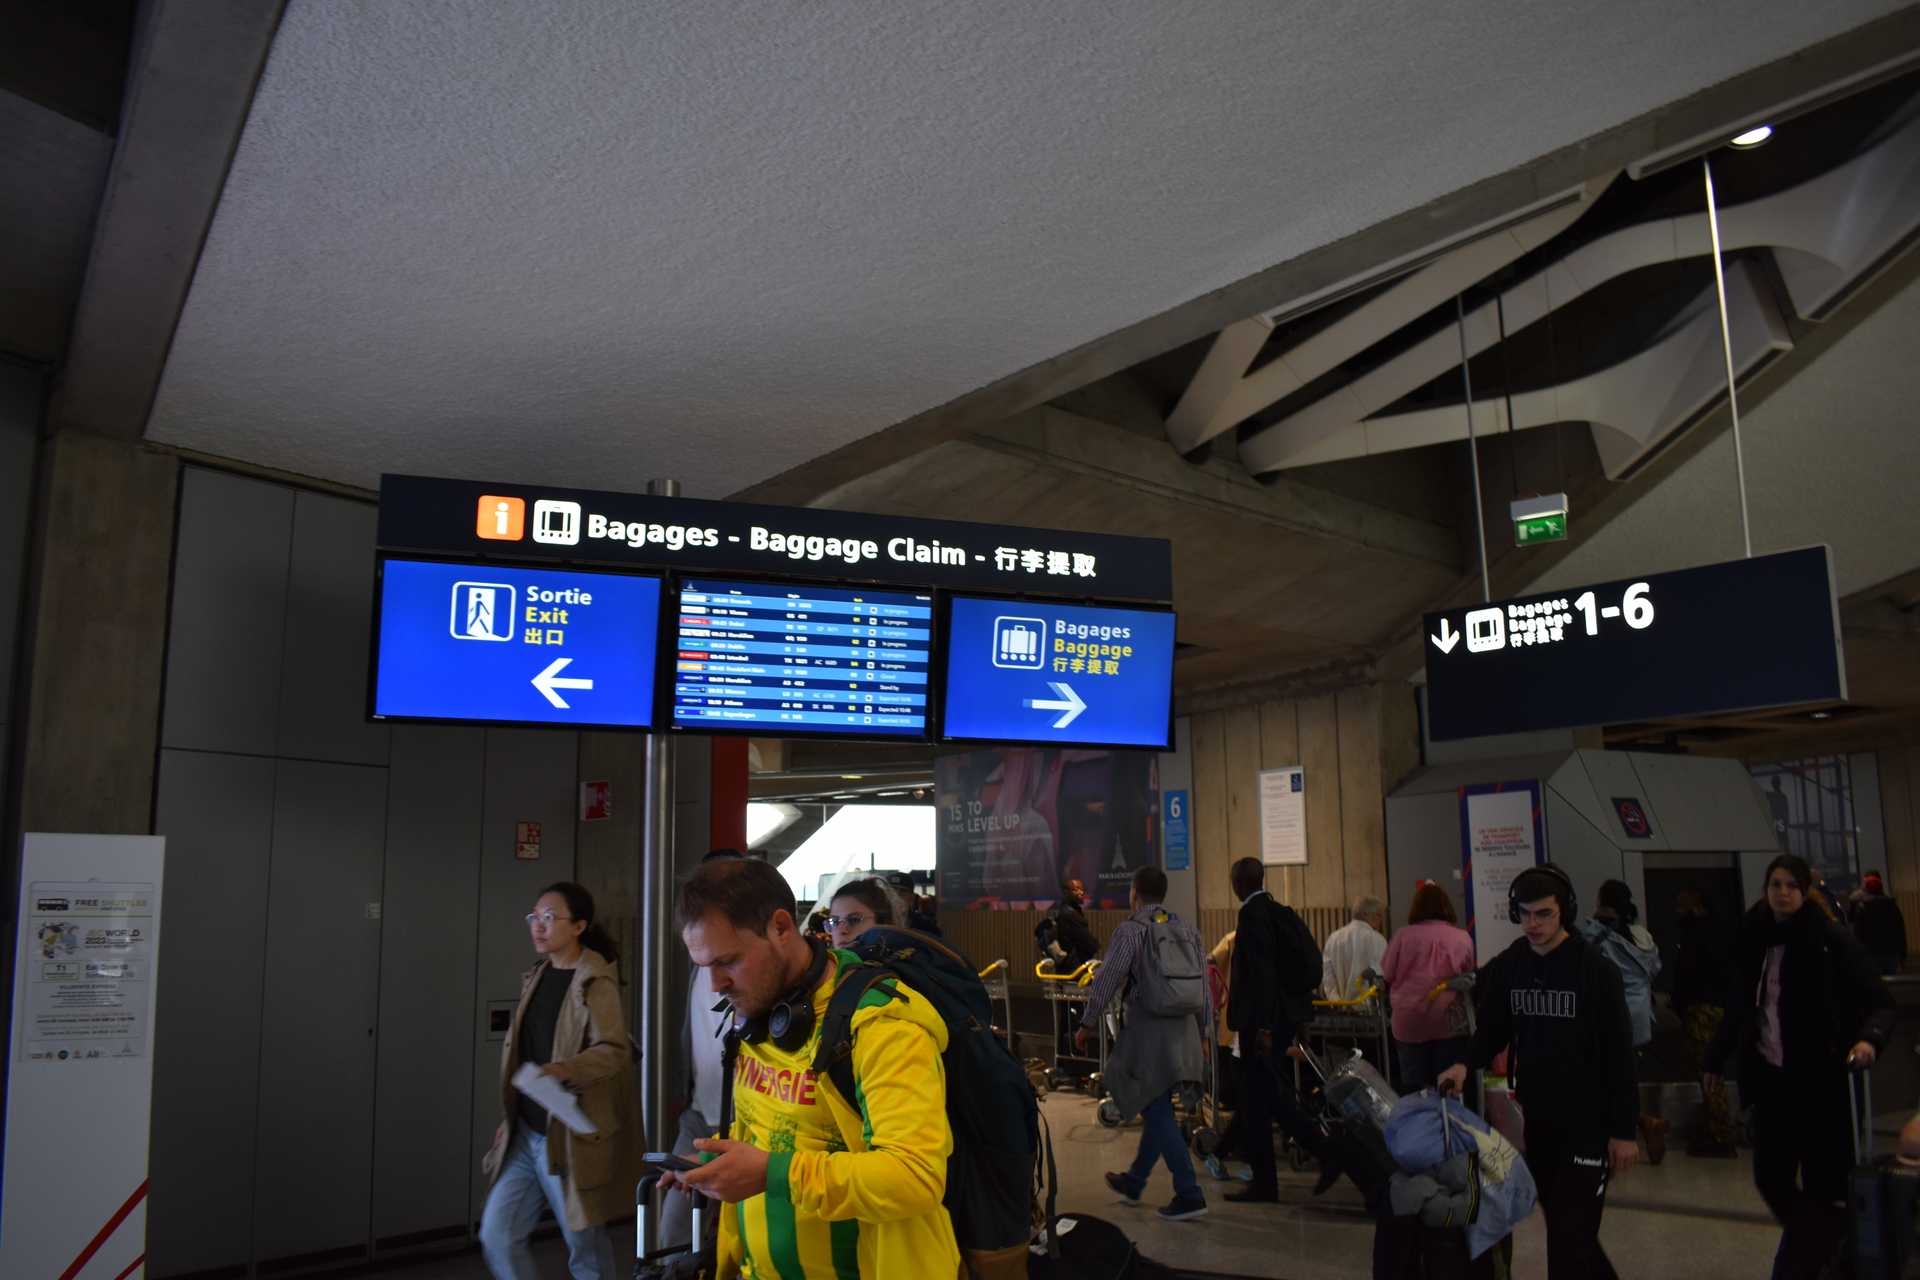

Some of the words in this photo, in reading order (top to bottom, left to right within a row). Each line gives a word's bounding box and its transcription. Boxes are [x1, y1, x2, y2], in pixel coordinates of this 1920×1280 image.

[587, 513, 719, 551] Bagages
[750, 526, 879, 564] Baggage
[887, 537, 966, 566] Claim
[994, 546, 1097, 578] 行李提取
[526, 585, 593, 605] Sortie
[525, 606, 569, 625] Exit
[1508, 598, 1569, 618] Bagages
[1574, 582, 1655, 636] 1-6
[1055, 619, 1130, 641] Bagages
[1508, 612, 1573, 633] Baggage
[524, 627, 564, 646] 出口
[1054, 638, 1133, 660] Baggage
[1053, 657, 1119, 675] 行李提取
[968, 801, 982, 815] TO
[1170, 796, 1181, 818] 6
[968, 815, 1001, 833] LEVEL
[1003, 814, 1020, 830] UP
[75, 899, 98, 907] FREE
[1510, 988, 1577, 1018] PUMA
[735, 1055, 817, 1106] YNERGIE
